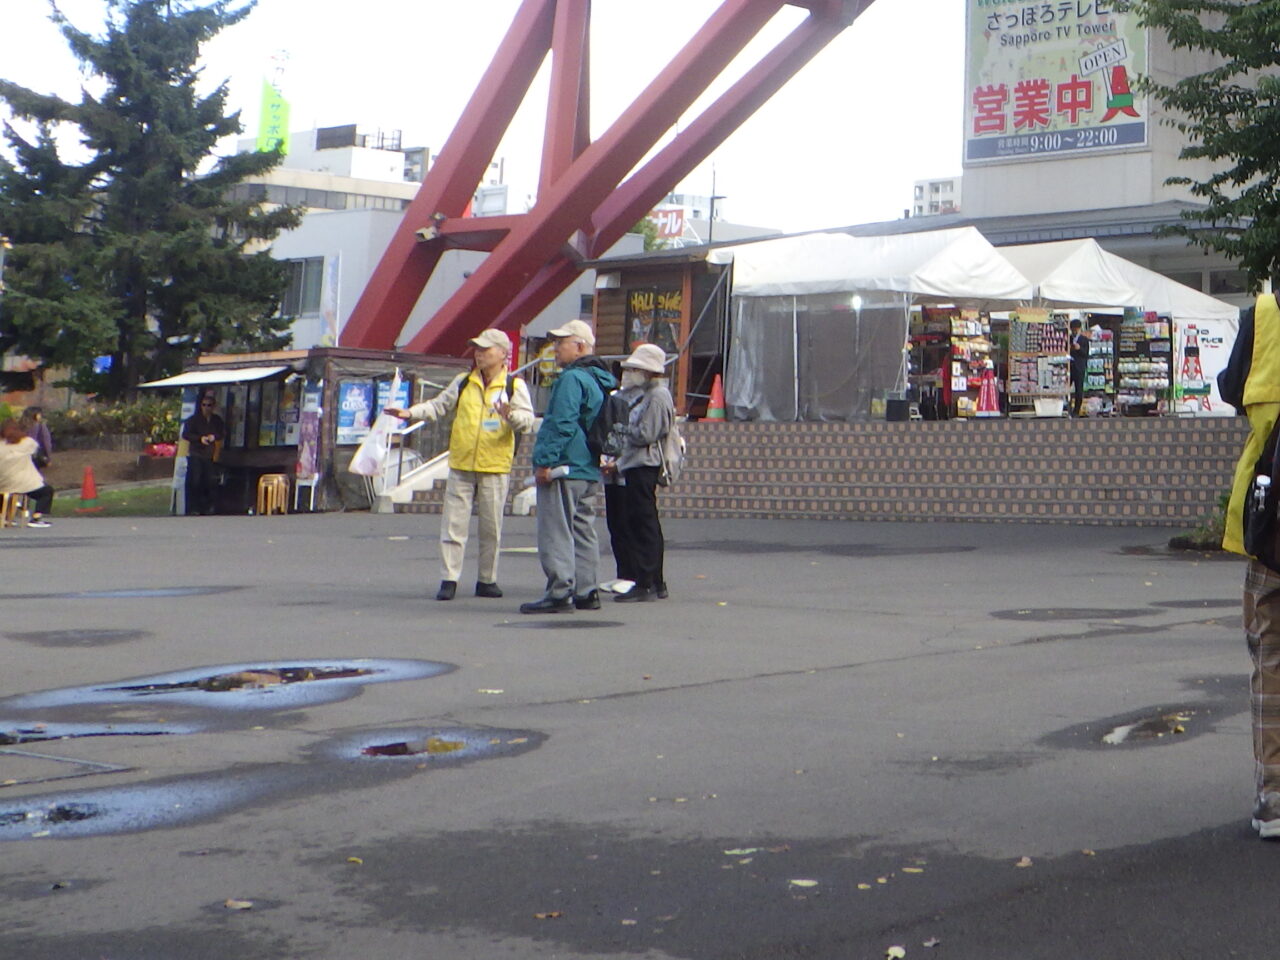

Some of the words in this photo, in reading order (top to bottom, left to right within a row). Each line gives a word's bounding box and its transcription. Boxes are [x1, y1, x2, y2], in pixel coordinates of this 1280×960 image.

[1000, 28, 1051, 49] Sapporo
[1055, 25, 1071, 39] TV
[1077, 21, 1114, 35] Tower
[1084, 46, 1122, 71] OPEN
[972, 74, 1093, 135] 営業中
